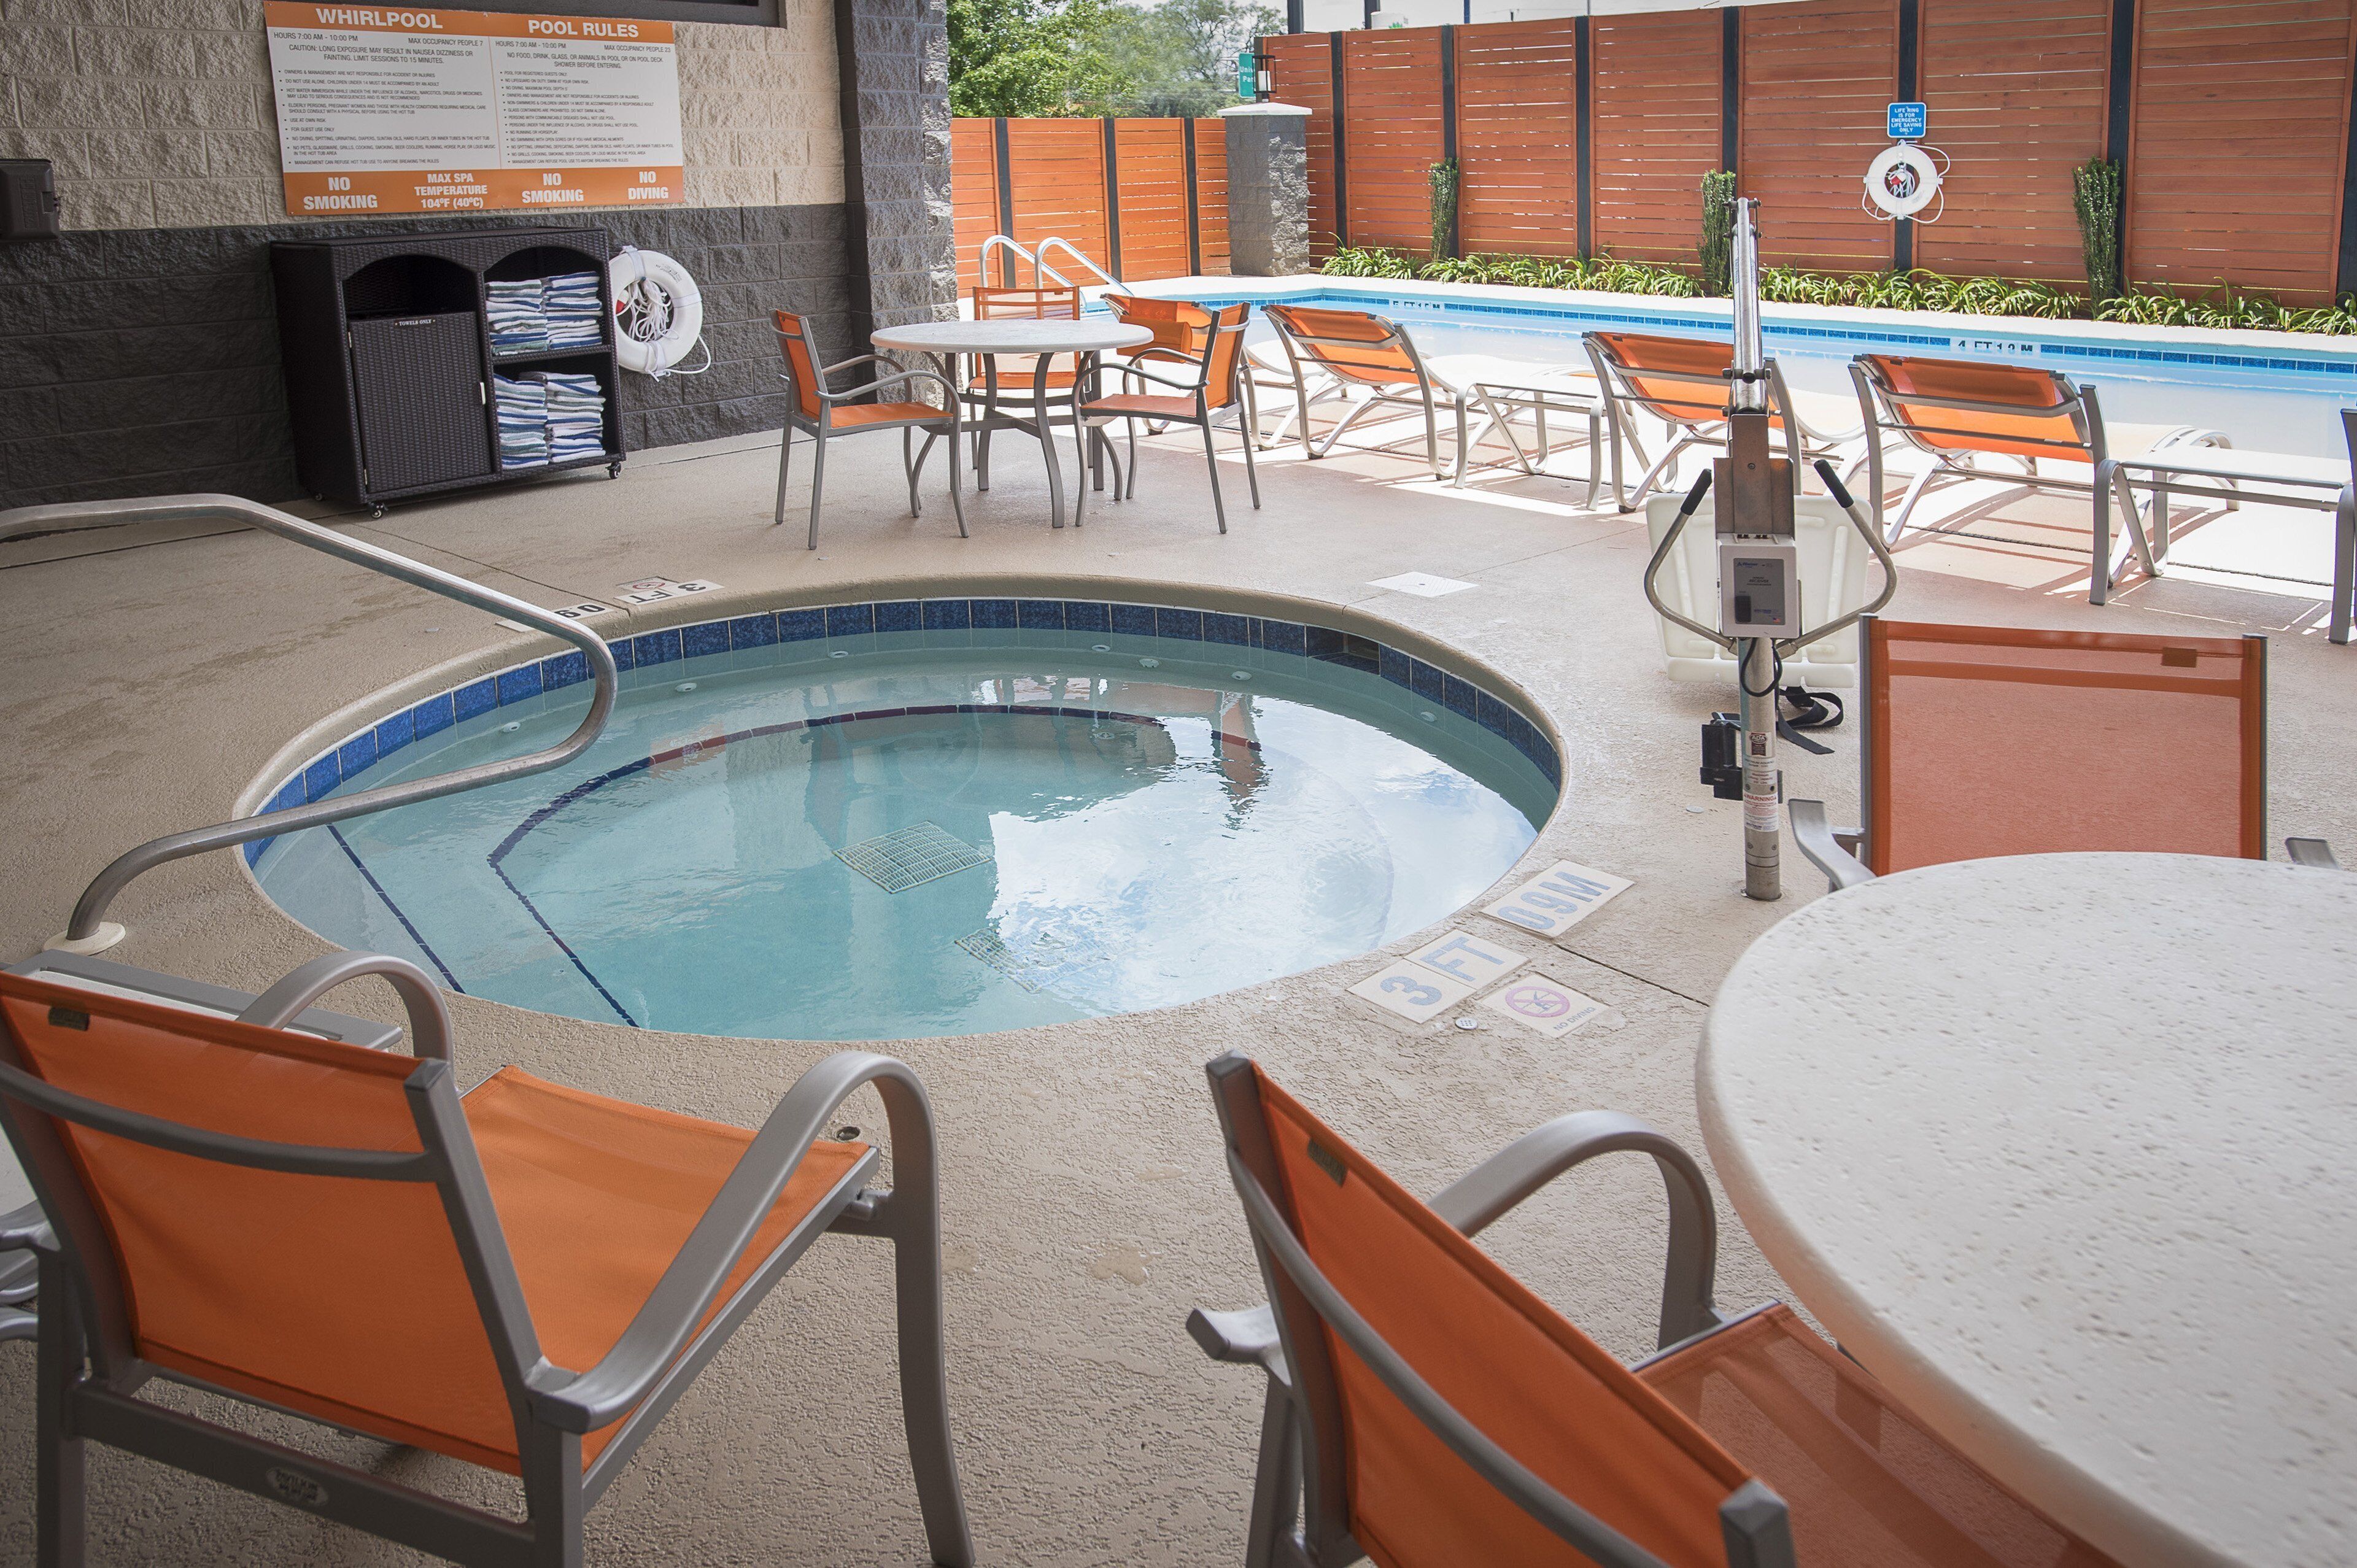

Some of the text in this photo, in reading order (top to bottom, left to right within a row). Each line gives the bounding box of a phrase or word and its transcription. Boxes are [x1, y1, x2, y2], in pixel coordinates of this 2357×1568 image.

[315, 8, 443, 29] WHIRLPOOL
[528, 20, 639, 38] POOL RULES
[328, 177, 350, 191] NO
[427, 172, 474, 183] MAX SPA
[543, 173, 562, 186] NO
[639, 171, 657, 183] NO
[414, 185, 488, 196] TEMPERATURE
[522, 189, 584, 203] SMOKING
[628, 187, 669, 200] DIVING
[303, 195, 378, 210] SMOKING
[629, 583, 706, 604] 3 FT
[1380, 936, 1506, 1006] 3 FT
[1553, 1006, 1595, 1032] NO DIVING
